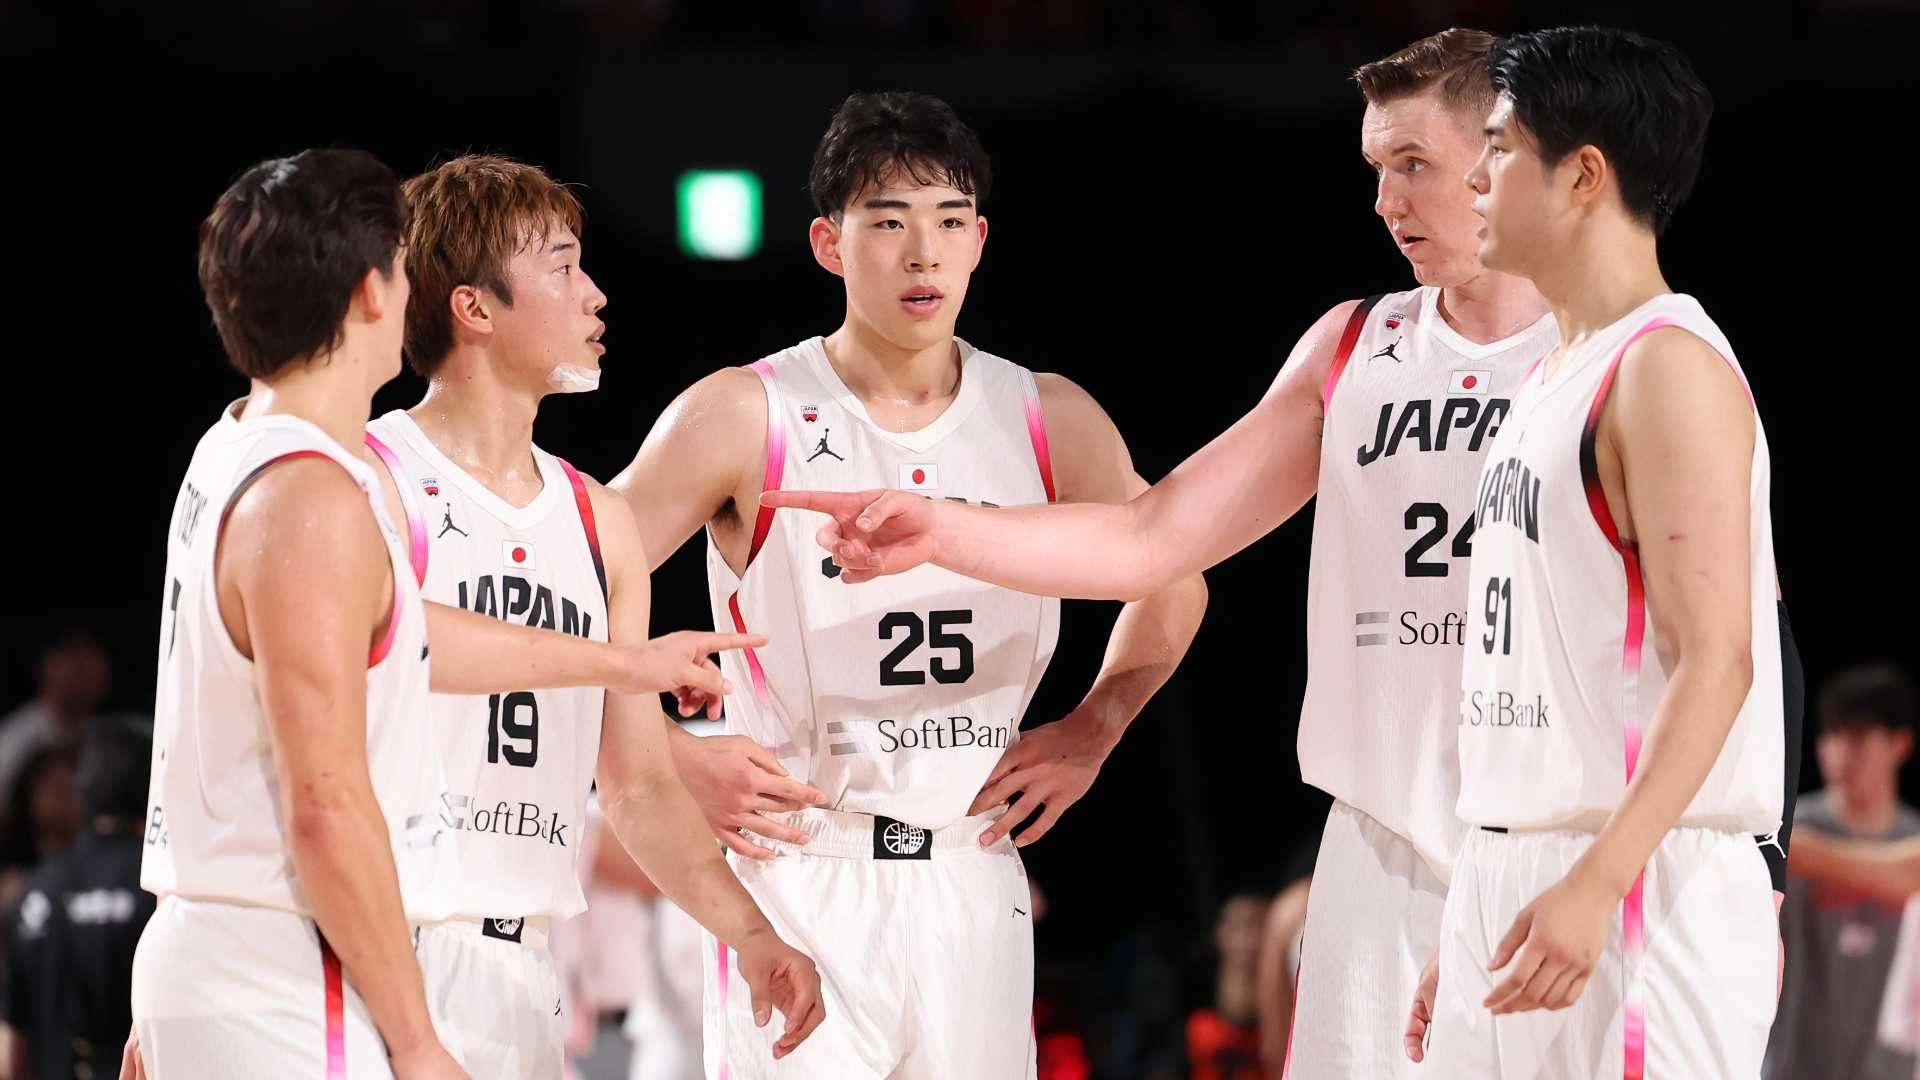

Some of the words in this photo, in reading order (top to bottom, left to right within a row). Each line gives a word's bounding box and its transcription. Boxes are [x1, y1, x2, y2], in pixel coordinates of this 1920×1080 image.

[1357, 398, 1511, 467] JAPA
[878, 609, 974, 686] 25
[1399, 611, 1468, 646] Soft
[1482, 577, 1512, 655] 91
[488, 691, 539, 768] 19
[878, 716, 1014, 753] SoftBan
[1470, 690, 1550, 729] StBank
